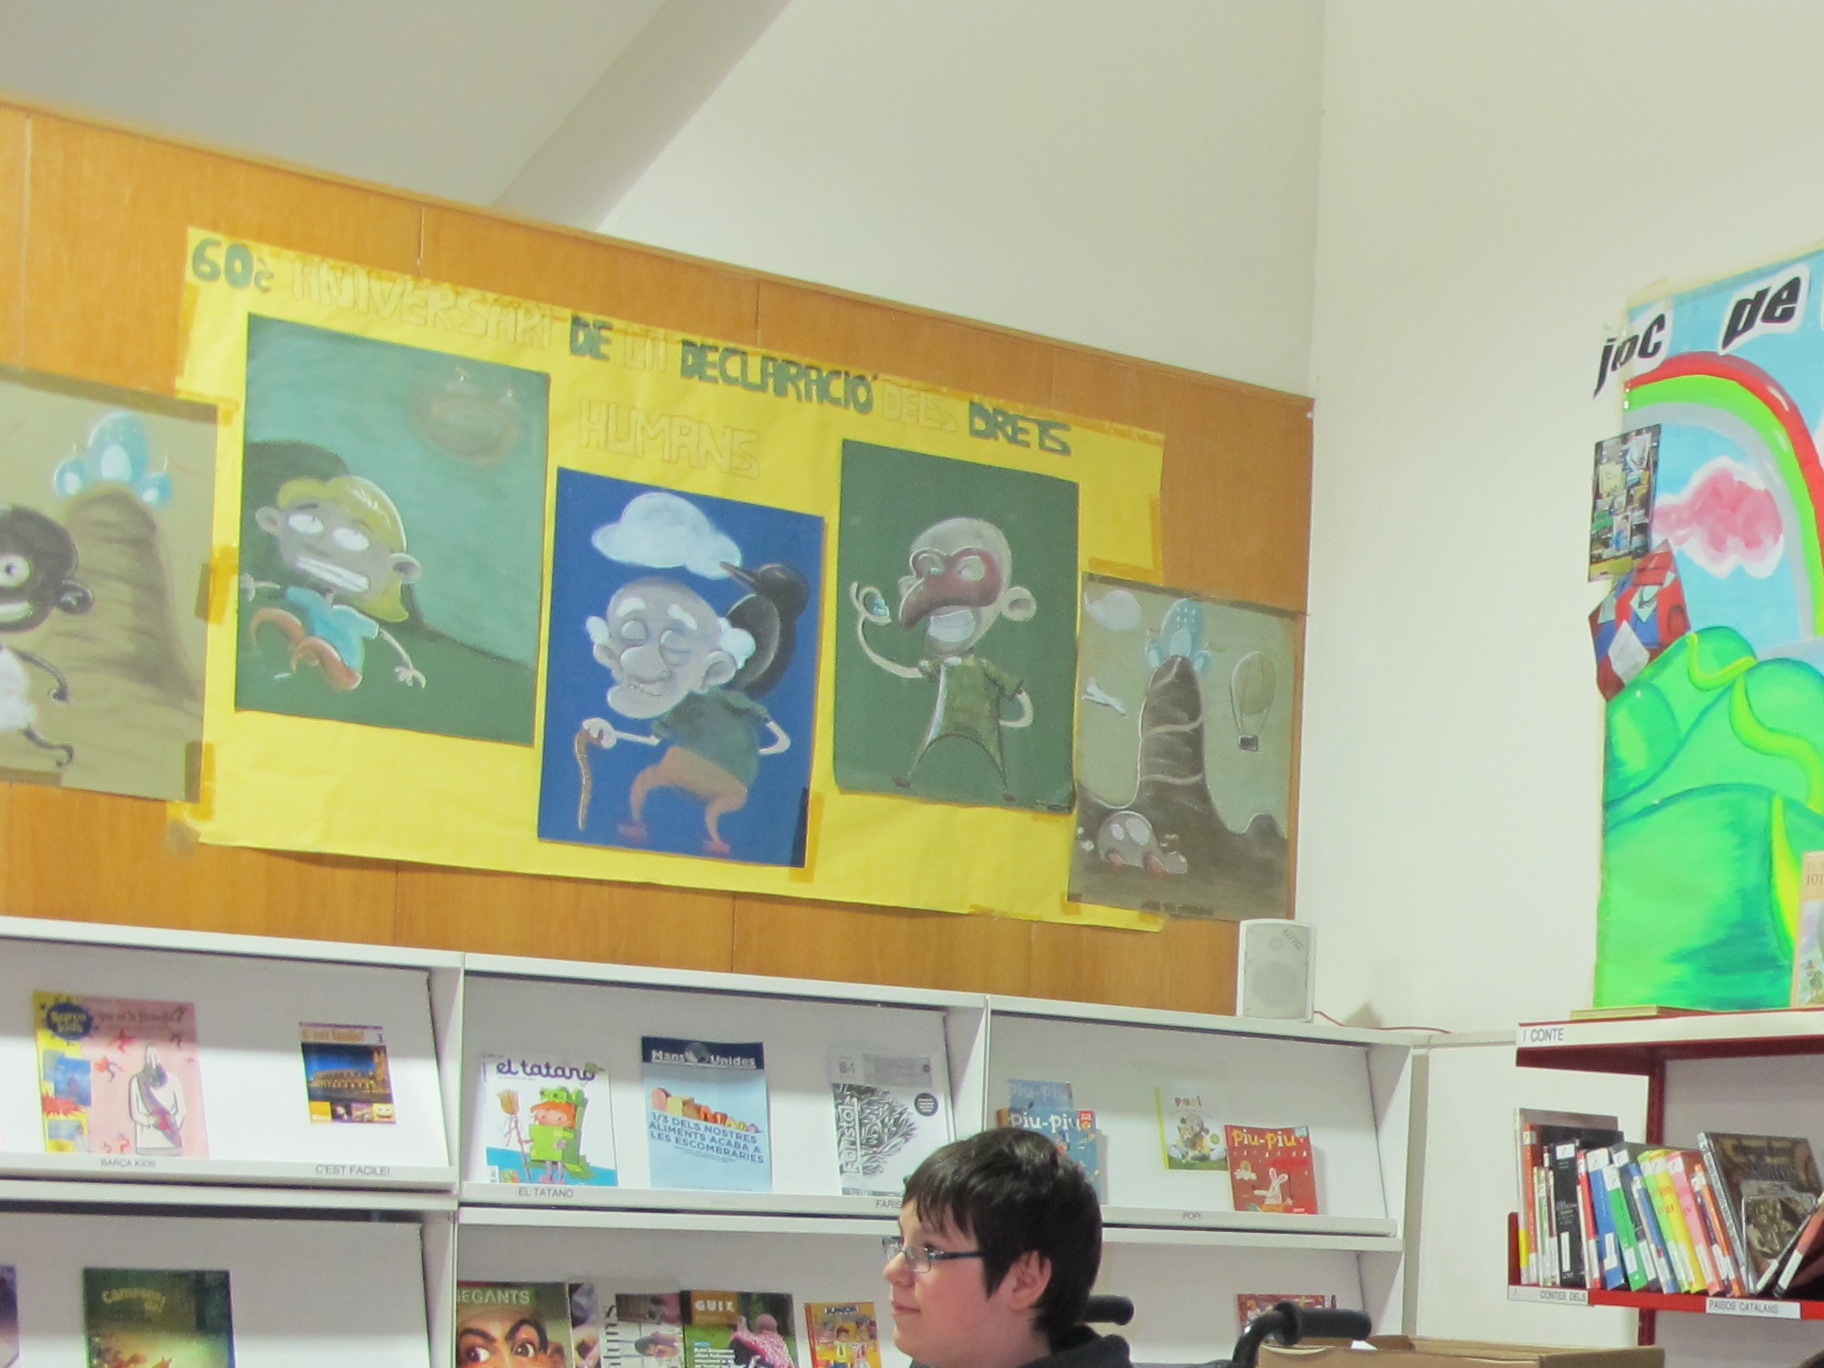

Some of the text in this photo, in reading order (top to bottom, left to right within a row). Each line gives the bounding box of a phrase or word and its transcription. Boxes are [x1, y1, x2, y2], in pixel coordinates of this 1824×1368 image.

[1720, 276, 1801, 352] de
[570, 314, 613, 361] DE
[968, 400, 1072, 457] DRETS
[578, 398, 761, 480] HUMANS
[1530, 1027, 1564, 1043] CONTE
[496, 1059, 596, 1082] el tatano
[651, 1049, 756, 1068] Mans Unides
[649, 1122, 707, 1142] ALIMENTS
[710, 1135, 749, 1151] ACABA
[652, 1112, 758, 1145] 1/3 DELS NOSTRES
[651, 1131, 672, 1143] LES
[675, 1136, 765, 1164] ESCOMBRARIES
[315, 1164, 347, 1175] C'EST
[518, 1187, 574, 1199] EL TATANO
